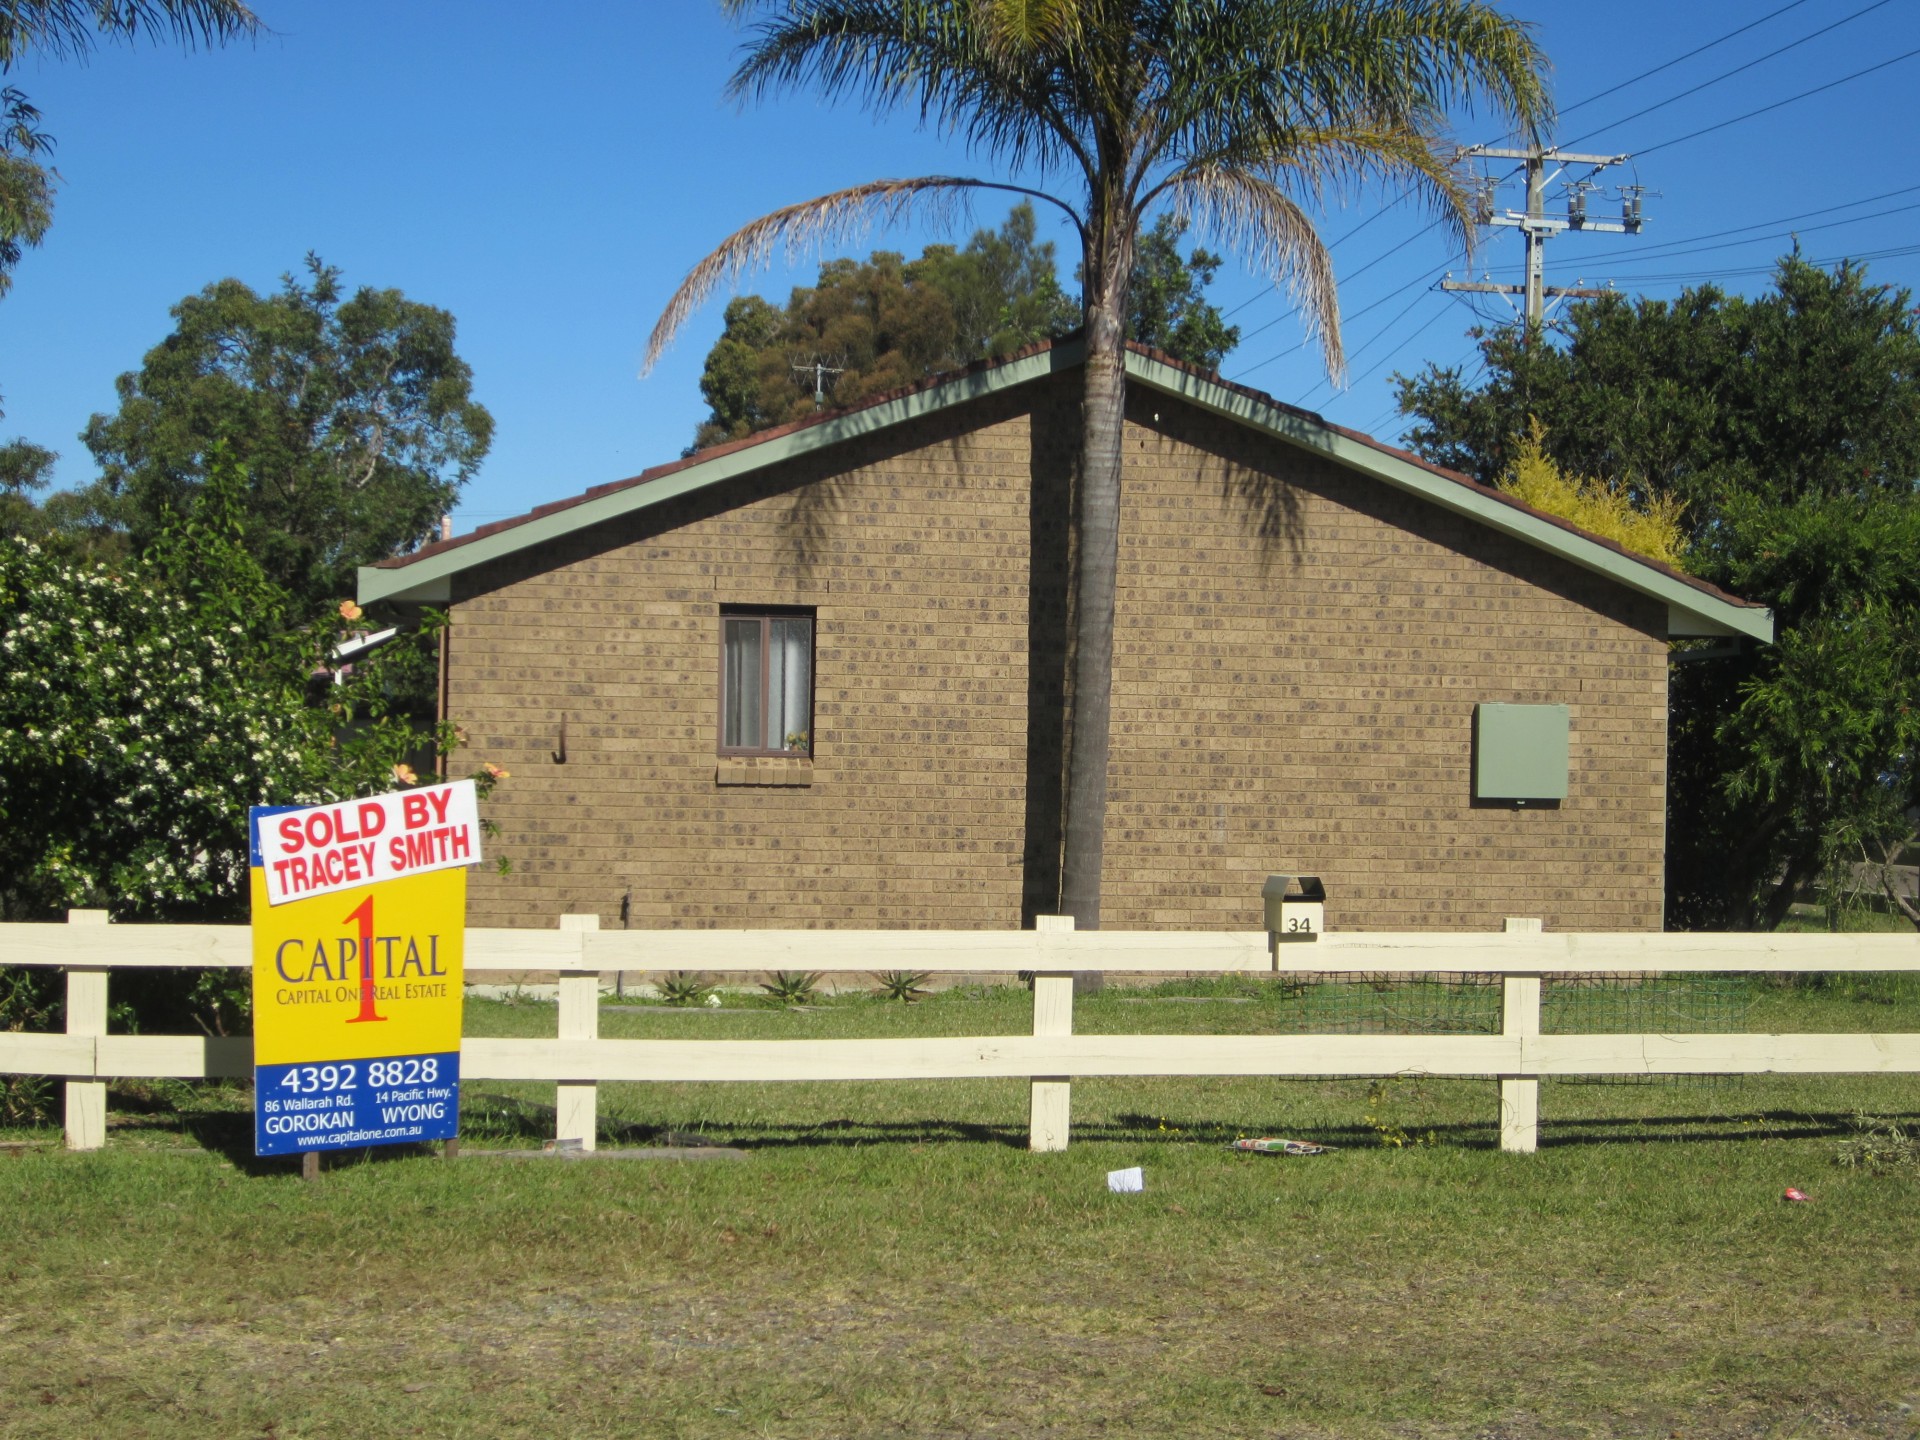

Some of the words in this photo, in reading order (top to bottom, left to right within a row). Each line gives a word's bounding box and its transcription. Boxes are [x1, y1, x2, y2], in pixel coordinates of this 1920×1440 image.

[279, 802, 386, 854] SOLD
[403, 788, 452, 830] BY
[273, 842, 376, 895] TRACEY
[389, 824, 470, 871] SMITH
[1288, 918, 1311, 933] 34
[276, 934, 447, 982] CAPITAL
[281, 1065, 357, 1093] 4392
[368, 1058, 438, 1087] 8828
[264, 1100, 280, 1112] 86
[282, 1096, 333, 1112] Wallarah
[336, 1094, 354, 1108] Rd.
[376, 1092, 388, 1103] 14
[391, 1089, 424, 1102] Pacific
[427, 1088, 452, 1102] Hwy.
[265, 1111, 354, 1134] GOROKAN
[382, 1102, 444, 1124] WYONG
[298, 1125, 422, 1147] www.capitalone.com.au
